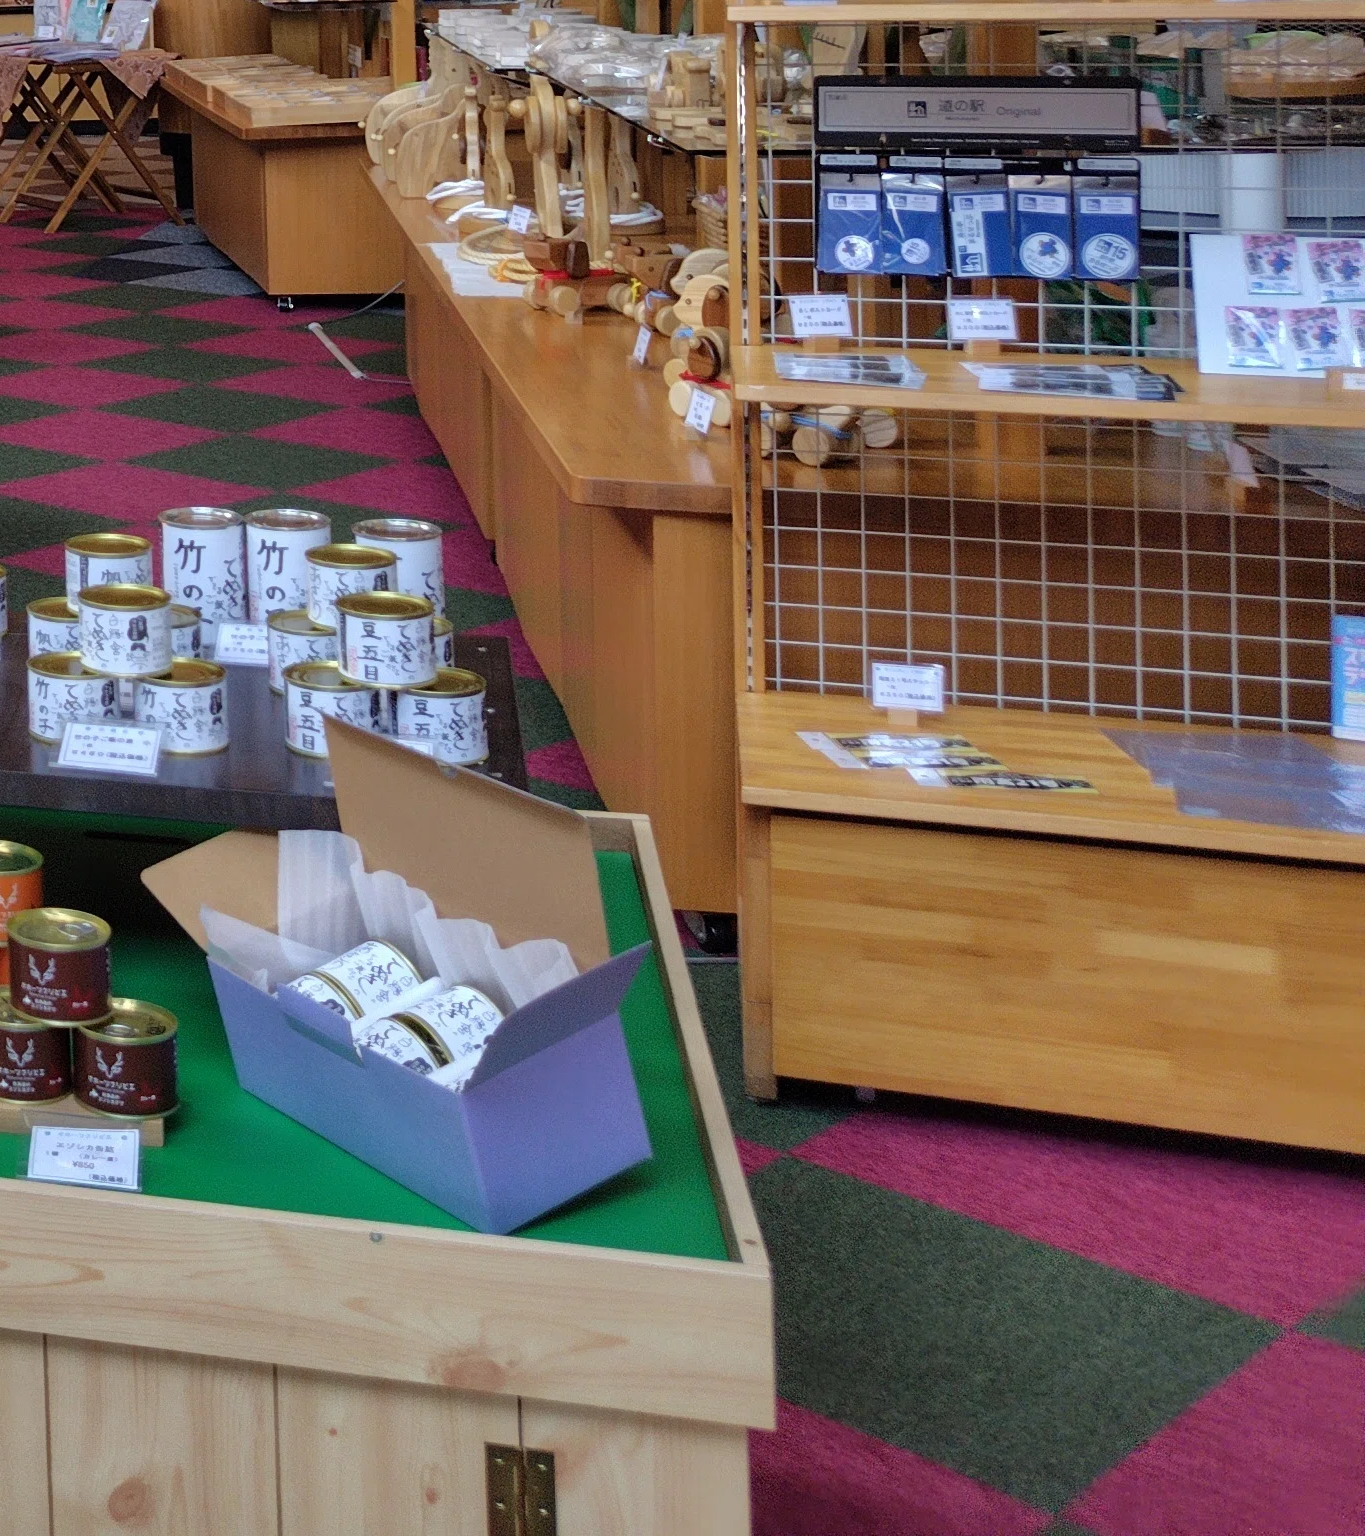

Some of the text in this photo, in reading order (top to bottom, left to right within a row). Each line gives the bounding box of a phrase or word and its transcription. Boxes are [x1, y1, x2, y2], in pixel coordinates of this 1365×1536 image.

[938, 98, 985, 113] 道の駅
[996, 106, 1042, 119] Original
[1112, 244, 1127, 261] 15
[357, 621, 385, 682] 豆五目
[35, 677, 55, 735] 竹の子
[297, 690, 323, 751] 豆五目
[56, 1141, 115, 1154] エゾシカ缶詰
[72, 1160, 95, 1170] ¥850
